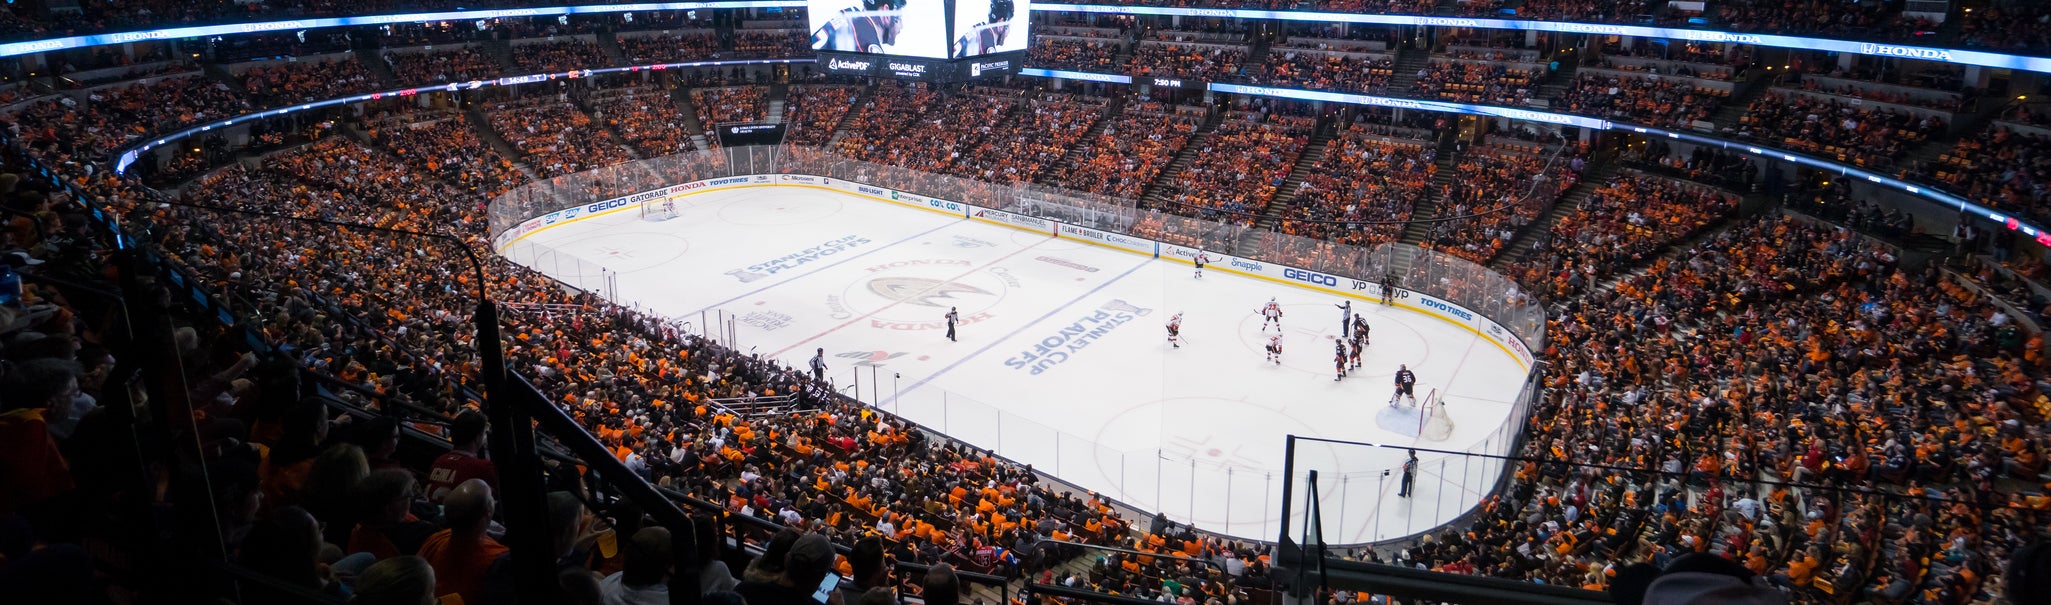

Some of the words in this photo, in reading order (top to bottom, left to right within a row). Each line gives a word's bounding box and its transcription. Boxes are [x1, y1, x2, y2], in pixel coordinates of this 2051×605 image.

[500, 8, 537, 16] HONDA
[1196, 9, 1235, 17] HONDA
[256, 21, 303, 31] HONDA
[1427, 19, 1478, 27] HONDA
[1571, 25, 1626, 35] HONDA
[125, 32, 170, 42] HONDA
[1701, 32, 1762, 44] HONDA
[21, 40, 63, 51] HONDA
[1878, 45, 1953, 61] HONDA
[838, 60, 868, 71] ActivePDF
[889, 62, 925, 73] GIGABLAST
[1076, 73, 1111, 82] HONDA
[1154, 78, 1168, 87] 7:50
[1170, 79, 1181, 88] PM
[1370, 97, 1422, 109] HONDA
[1514, 109, 1573, 125] HONDA
[670, 181, 707, 193] HONDA
[709, 178, 728, 187] TOYO
[729, 176, 749, 184] TIRES
[630, 189, 668, 203] GATORADE
[858, 186, 869, 194] BUD
[869, 188, 883, 196] LIGHT
[588, 197, 627, 213] GEICO
[984, 209, 1009, 218] MERCURY
[1062, 225, 1078, 235] FLAME
[1083, 229, 1104, 240] BROILER
[747, 244, 822, 272] STANLEY
[822, 234, 858, 247] CUP
[766, 237, 872, 275] PLAYOFFS
[865, 258, 973, 273] HONDA
[1231, 257, 1263, 272] Snapple
[1284, 268, 1337, 287] GEICO
[1352, 280, 1367, 291] yp
[1394, 288, 1409, 300] yp
[1420, 297, 1448, 312] TOYO
[1447, 306, 1473, 322] TIRES
[1066, 311, 1134, 354] STANLEY
[1004, 309, 1111, 370] PLAYOFFS
[1029, 351, 1069, 376] CUP
[1402, 375, 1412, 383] 36
